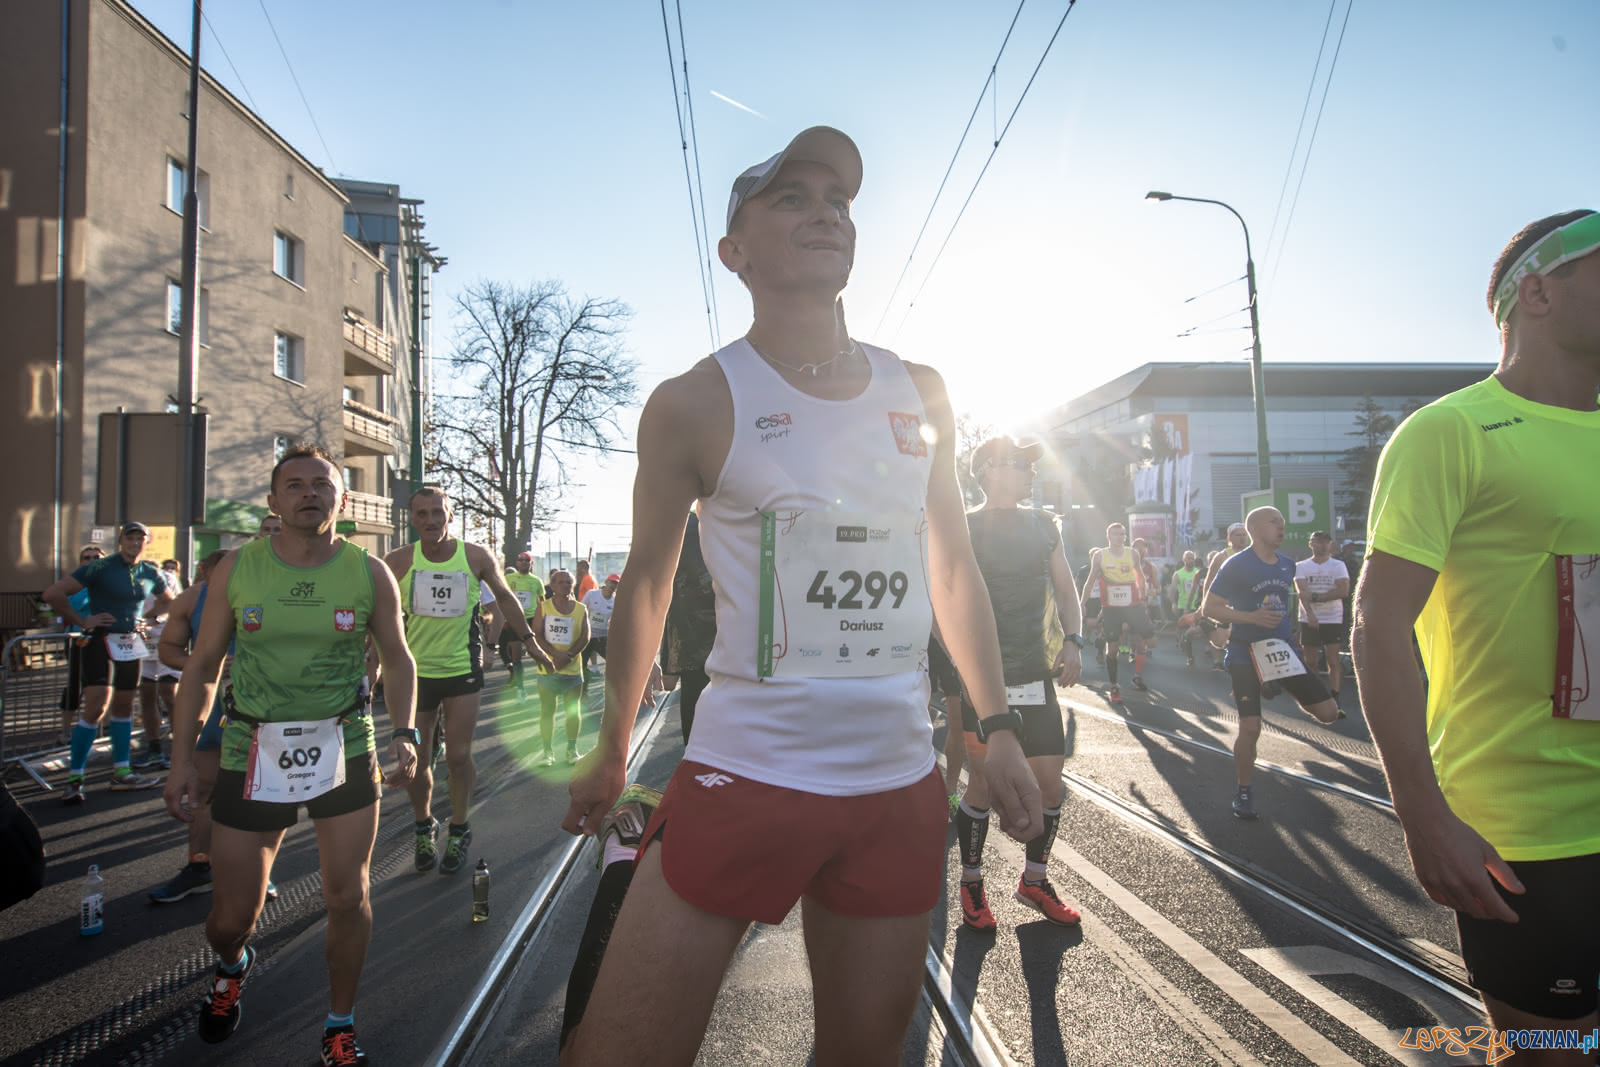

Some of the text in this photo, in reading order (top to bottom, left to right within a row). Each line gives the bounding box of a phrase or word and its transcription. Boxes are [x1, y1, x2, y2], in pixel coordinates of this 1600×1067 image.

[1287, 492, 1316, 524] B
[431, 586, 451, 599] 161
[806, 570, 909, 609] 4299
[549, 624, 568, 634] 3875
[839, 619, 884, 631] Dariusz
[1265, 650, 1290, 664] 1139
[278, 746, 321, 770] 609
